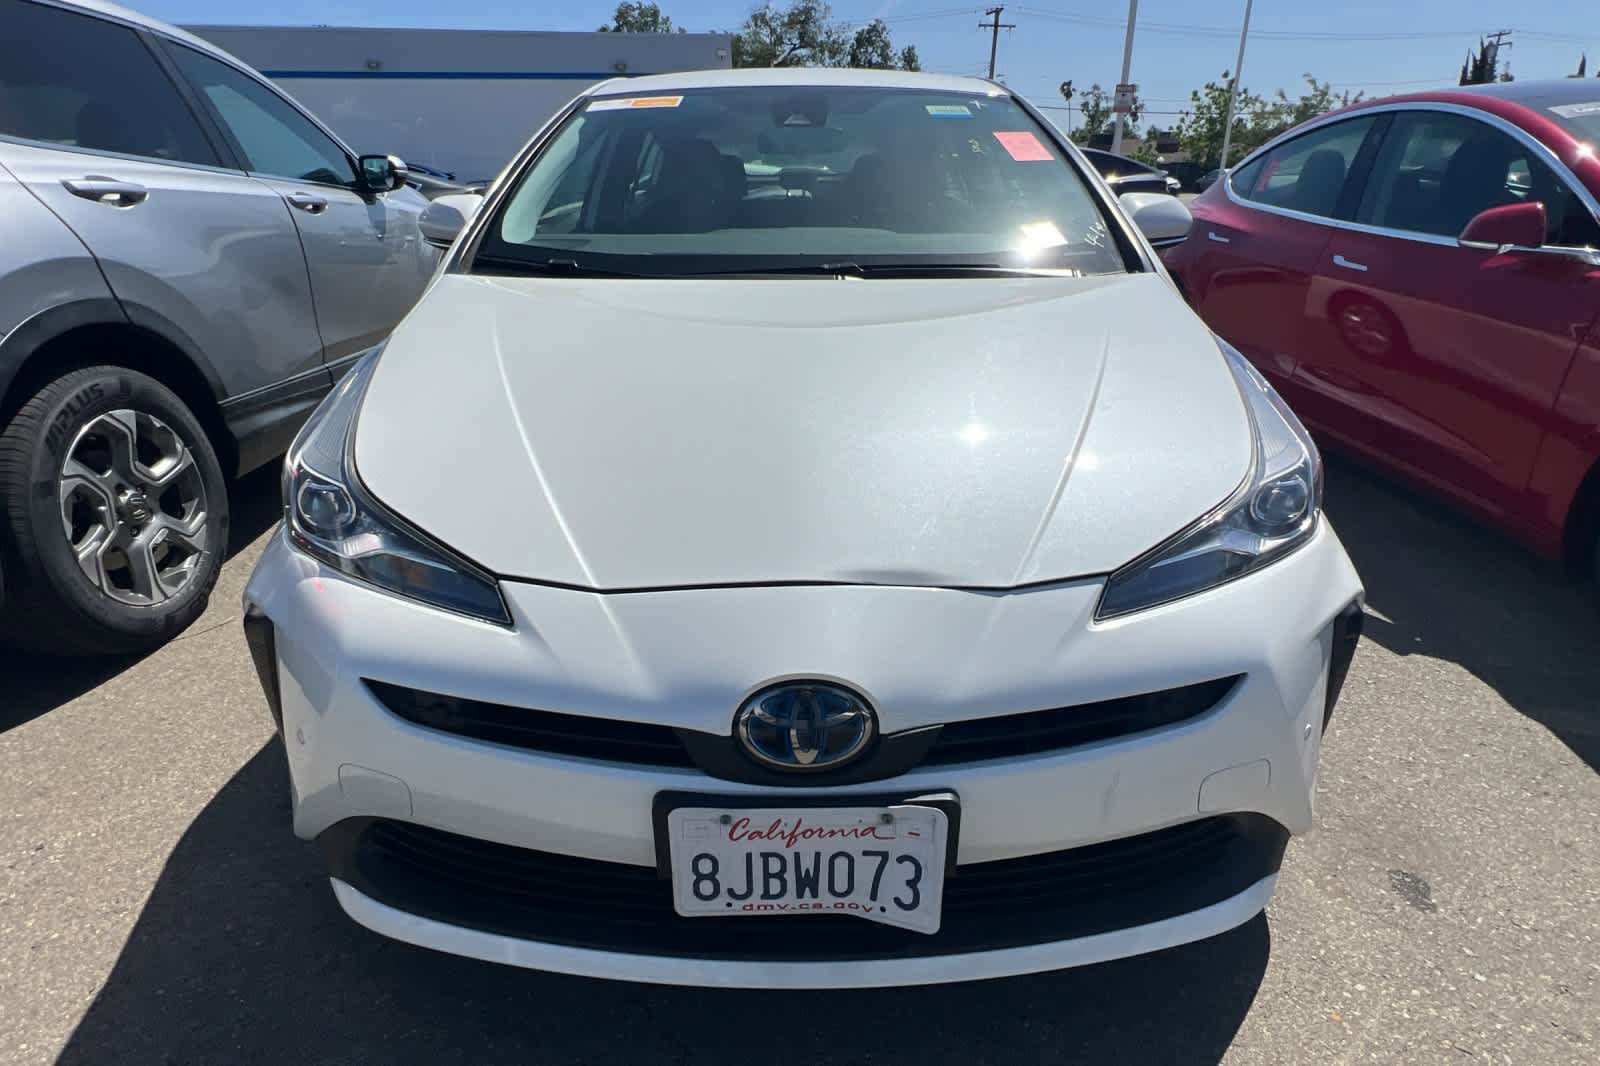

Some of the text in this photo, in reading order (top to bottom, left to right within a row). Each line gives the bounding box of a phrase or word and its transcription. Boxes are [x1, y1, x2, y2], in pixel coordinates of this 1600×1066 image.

[728, 817, 896, 848] California
[691, 850, 923, 912] 8JBW073
[742, 901, 873, 913] dmv.ca.gov
